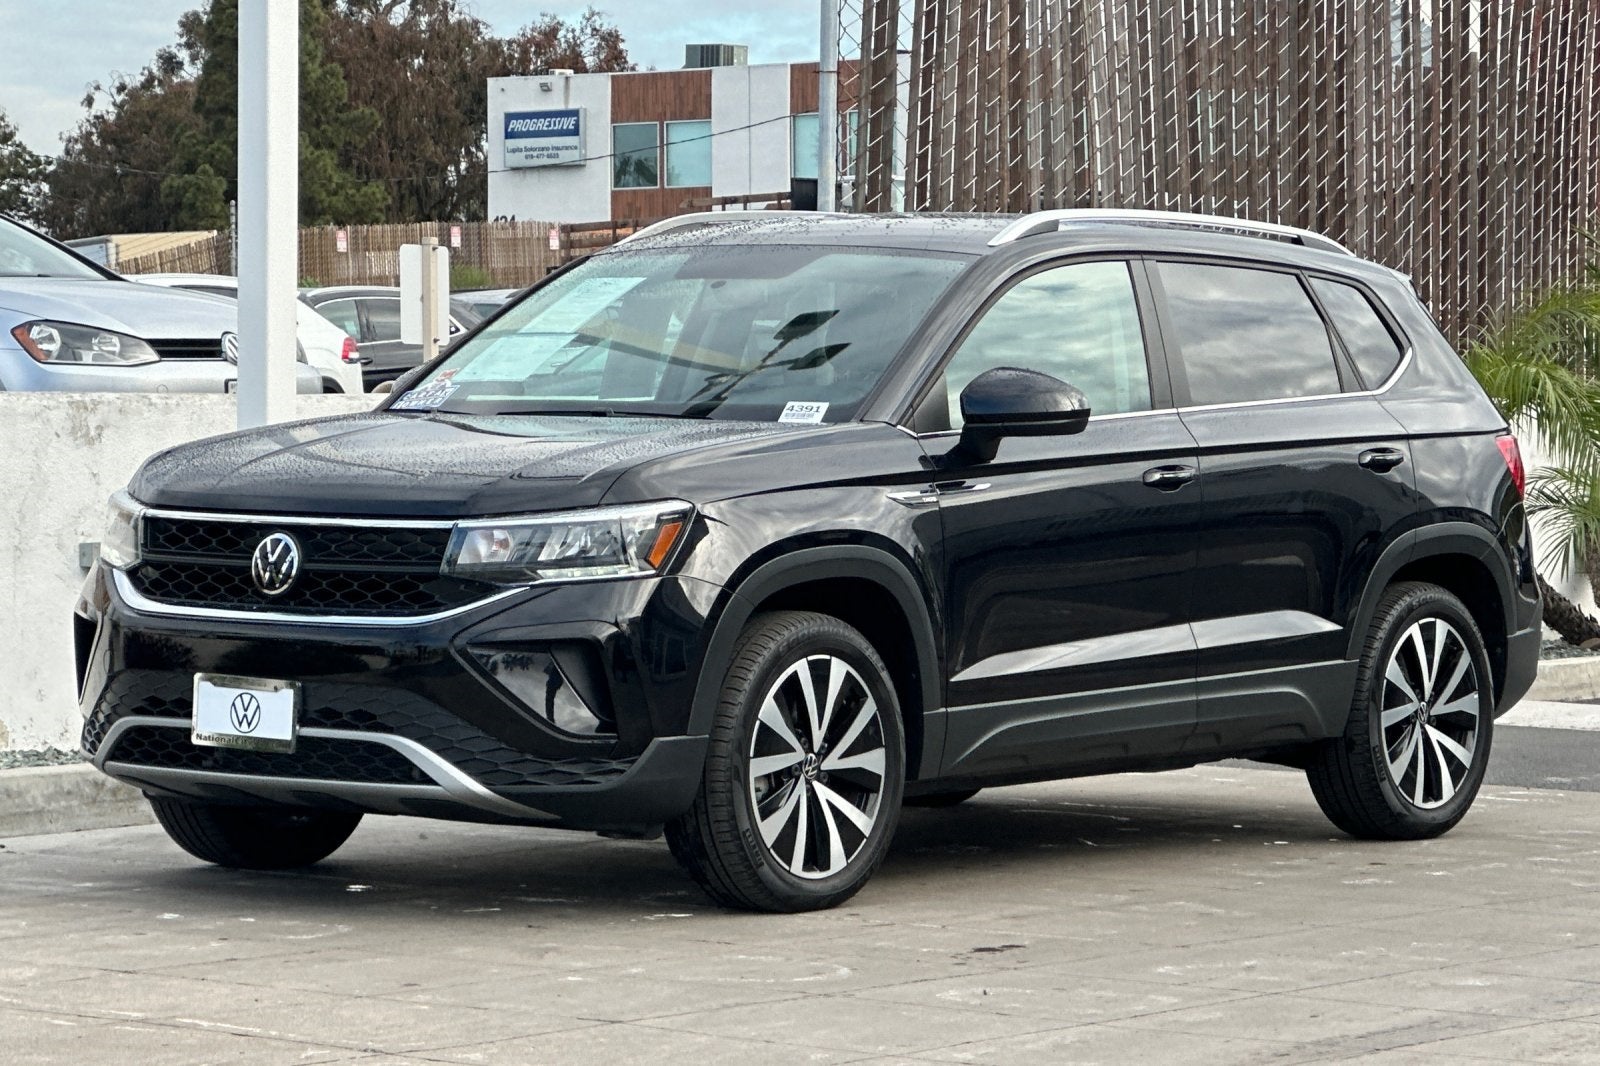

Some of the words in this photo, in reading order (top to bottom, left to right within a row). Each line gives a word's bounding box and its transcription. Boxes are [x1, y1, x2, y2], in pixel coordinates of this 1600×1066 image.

[508, 117, 577, 132] PROGRESSIVE
[507, 146, 523, 154] Lupita
[786, 404, 821, 413] 4391
